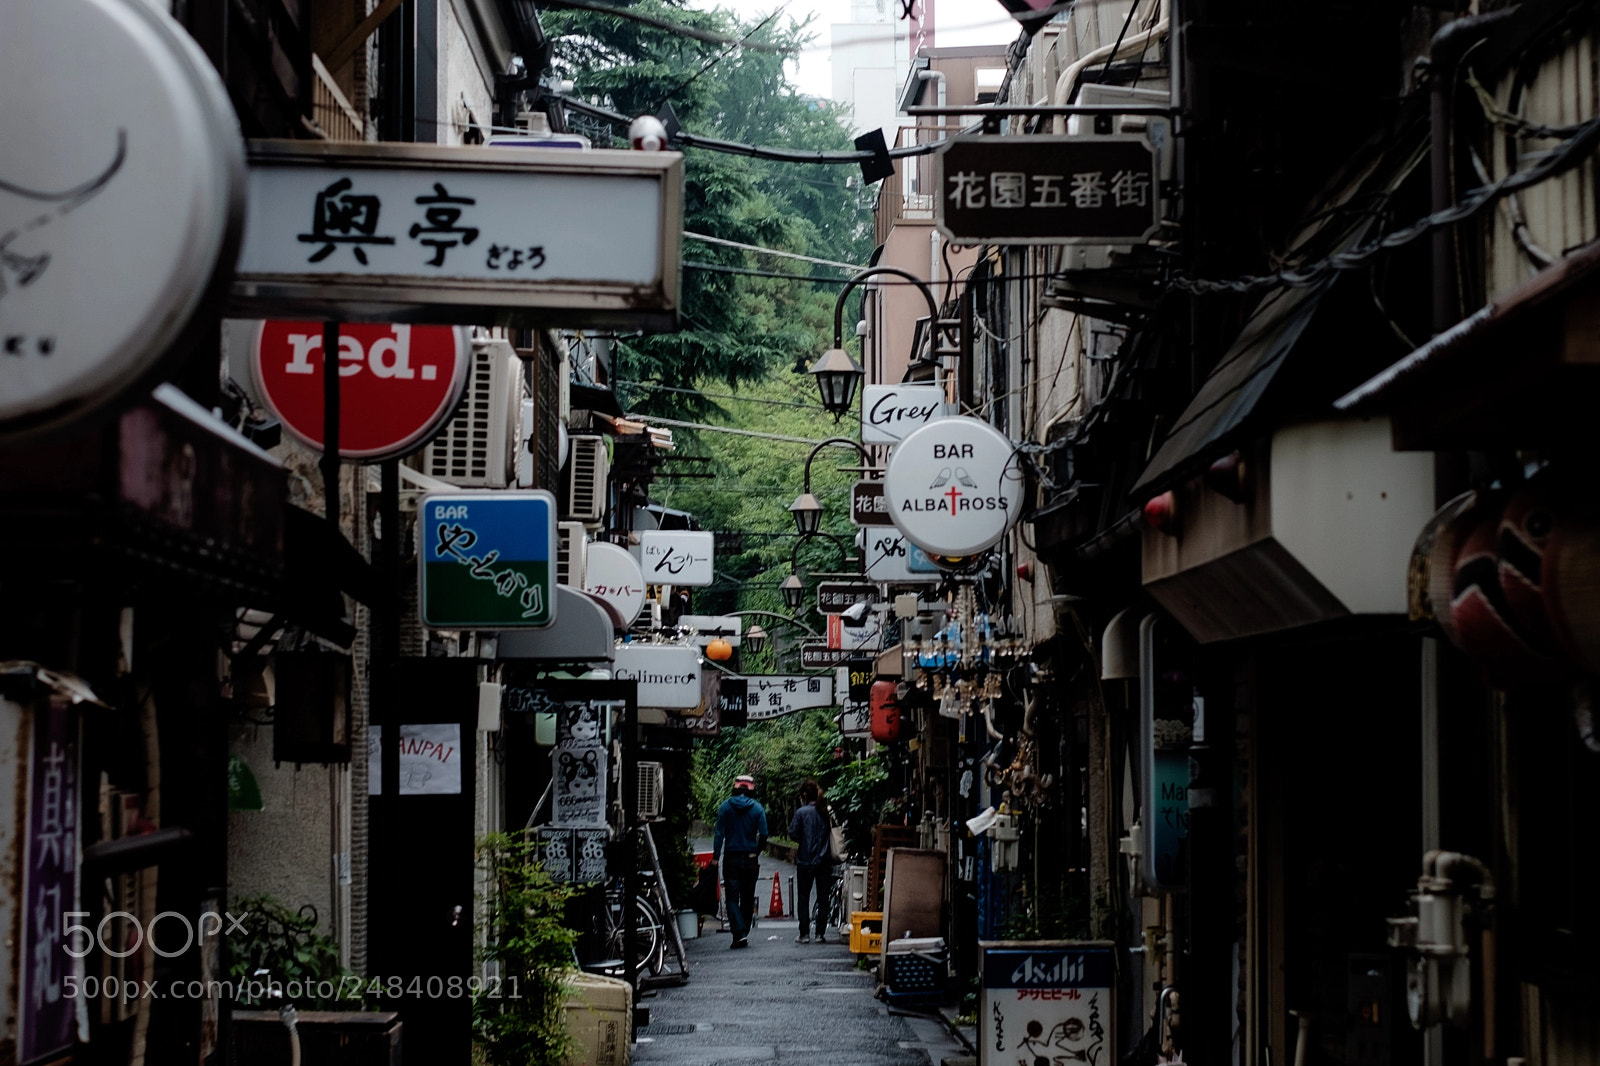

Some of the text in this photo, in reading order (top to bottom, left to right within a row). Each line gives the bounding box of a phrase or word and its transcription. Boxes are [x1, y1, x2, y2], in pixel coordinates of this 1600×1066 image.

[948, 169, 1150, 210] 花園五番街
[286, 324, 438, 381] red.
[869, 393, 939, 425] Grey
[933, 444, 974, 459] BAR
[434, 505, 469, 520] BAR
[902, 486, 1008, 516] ALBATROSS
[614, 669, 691, 685] Calimero
[380, 737, 453, 763] ANPAI
[1011, 954, 1084, 984] Asahi
[1017, 990, 1081, 1000] アサヒビール
